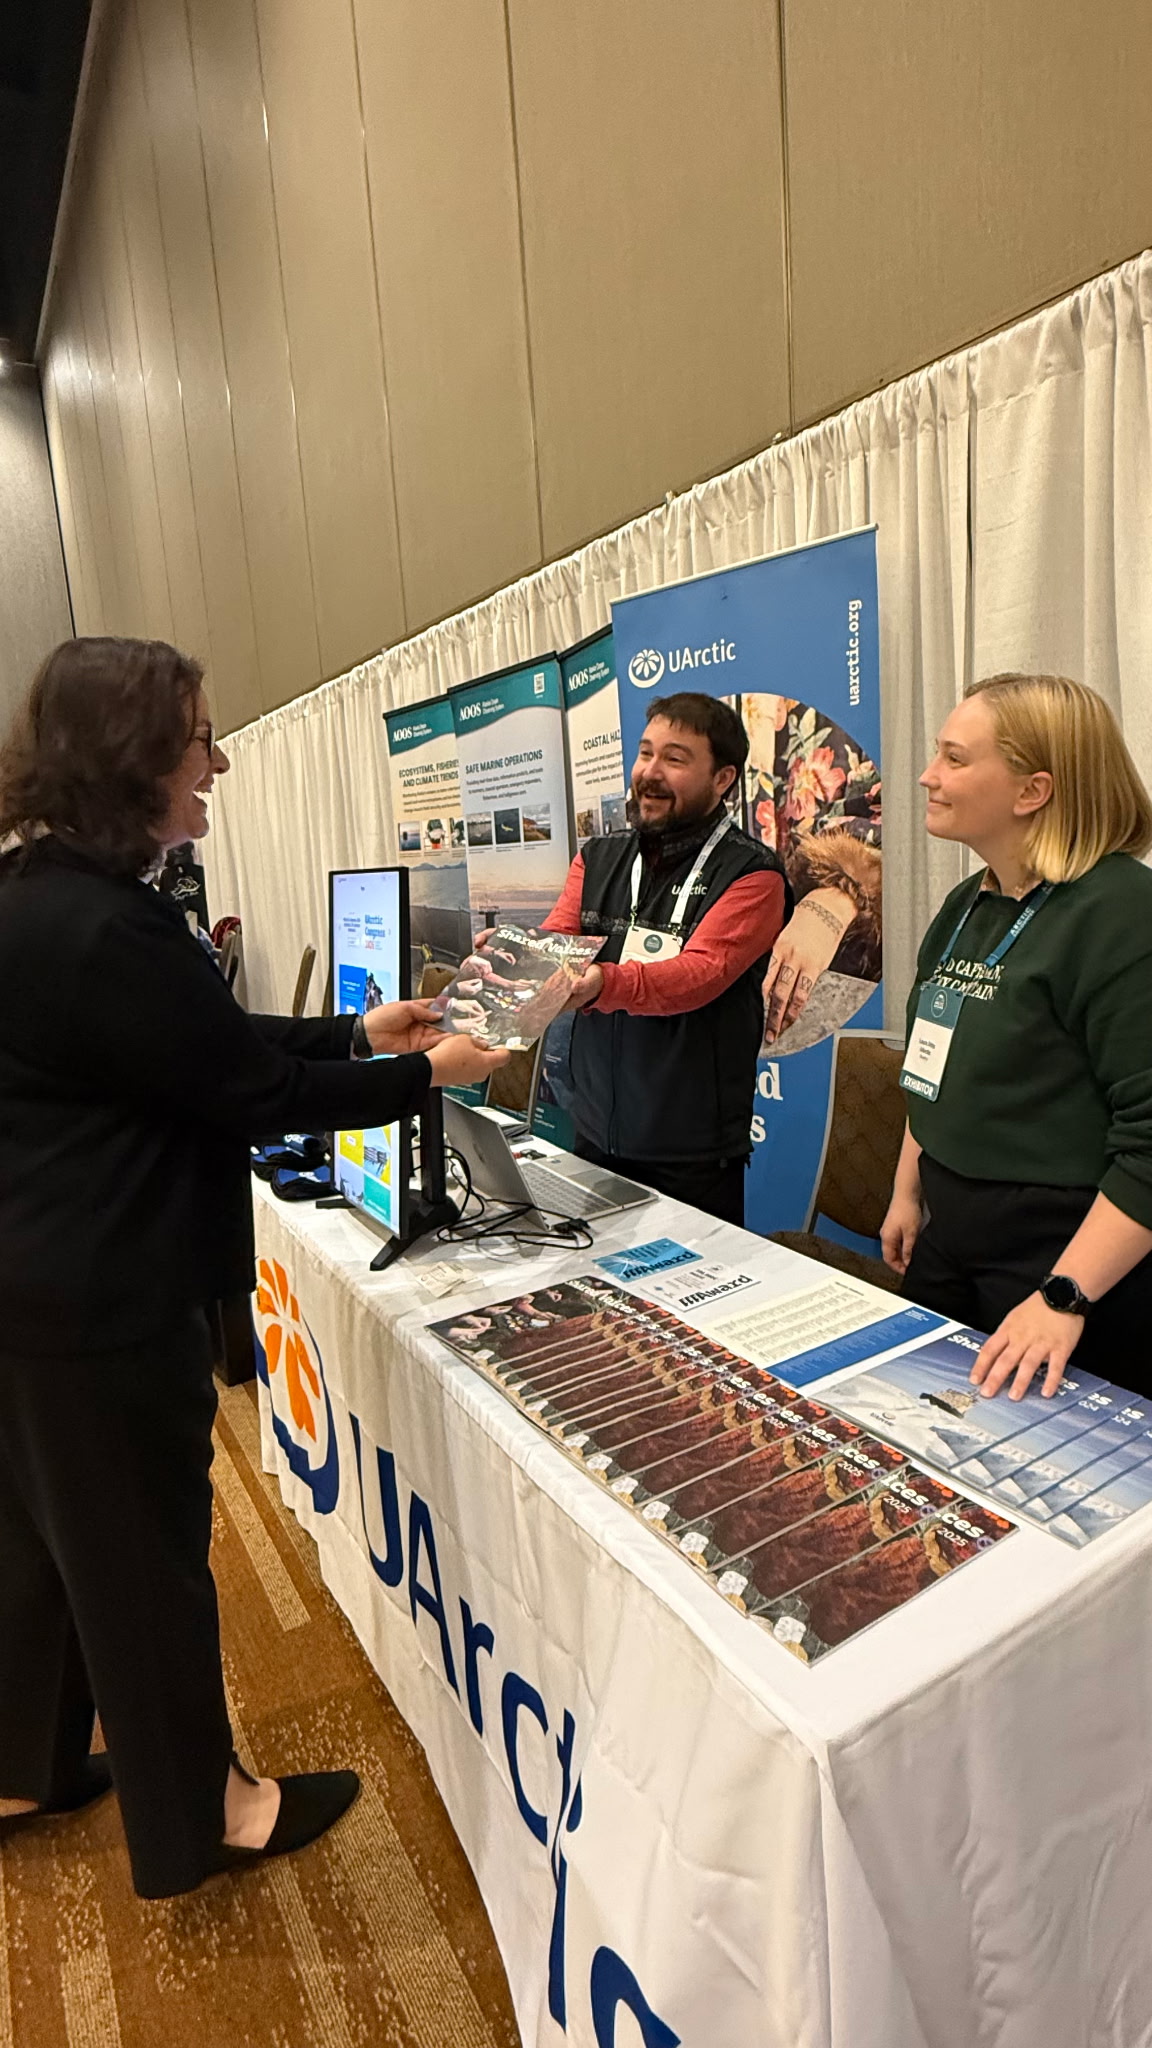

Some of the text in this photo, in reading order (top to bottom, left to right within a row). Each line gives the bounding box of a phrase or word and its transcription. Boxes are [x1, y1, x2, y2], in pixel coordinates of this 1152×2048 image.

[667, 639, 737, 673] UArctic
[846, 599, 862, 706] uarctic.org
[459, 703, 482, 721] AOOS
[583, 733, 610, 751] COASTAL
[398, 763, 436, 778] ECOSYSTEMS,
[465, 749, 543, 775] SAFE MARINE OPERATIONS
[403, 770, 459, 787] AND CLIMATE TRENDS
[903, 1074, 934, 1097] EXHIBITOR
[796, 1434, 821, 1448] 2025
[837, 1460, 865, 1477] 2025
[839, 1447, 881, 1470] ces
[883, 1495, 912, 1514] 2025
[935, 1511, 985, 1538] ces
[936, 1526, 969, 1547] 2025
